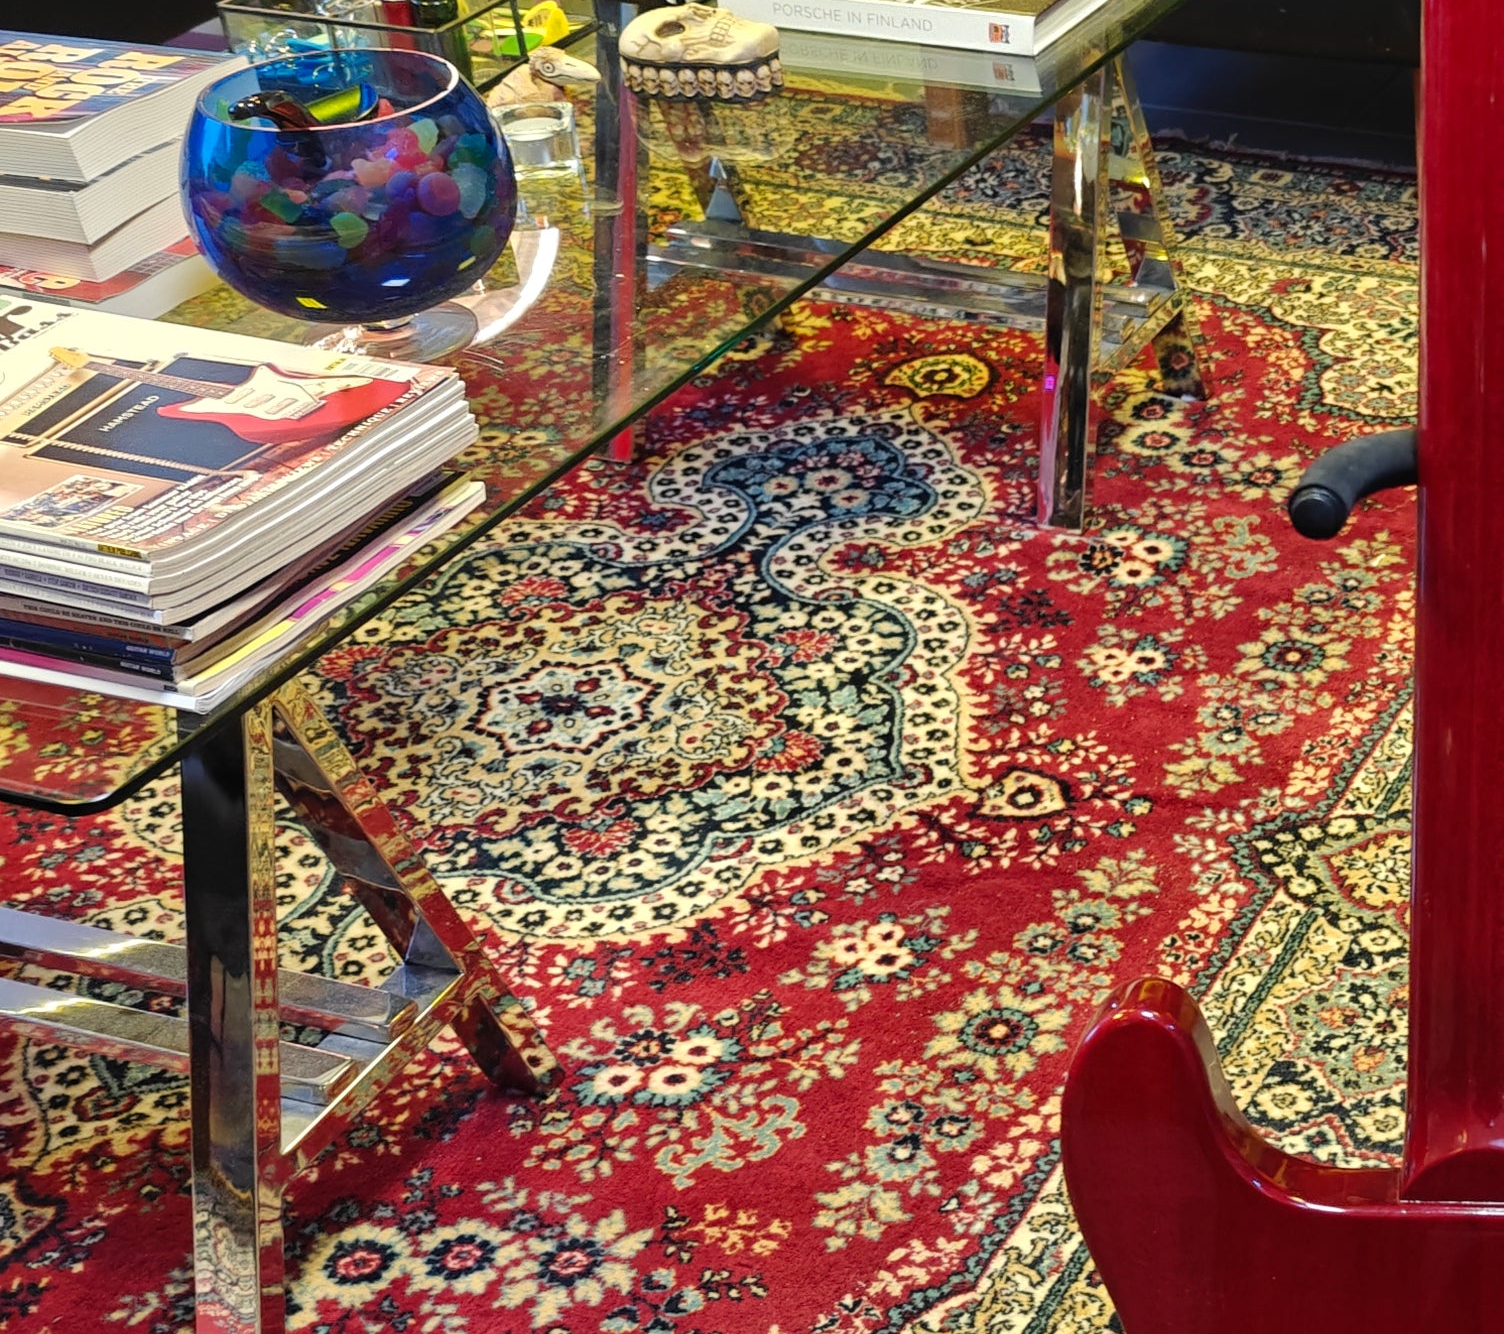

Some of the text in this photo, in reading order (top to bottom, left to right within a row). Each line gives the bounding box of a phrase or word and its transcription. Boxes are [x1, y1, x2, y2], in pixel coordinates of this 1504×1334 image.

[772, 2, 933, 32] PORSCHE IN FINLAND
[0, 51, 187, 118] ROCK
[98, 395, 160, 432] HAMSTEAD
[326, 407, 393, 450] TECHNIQUE
[126, 645, 171, 657] GUITAR WORLD
[120, 661, 161, 675] GUITAR WORLD
